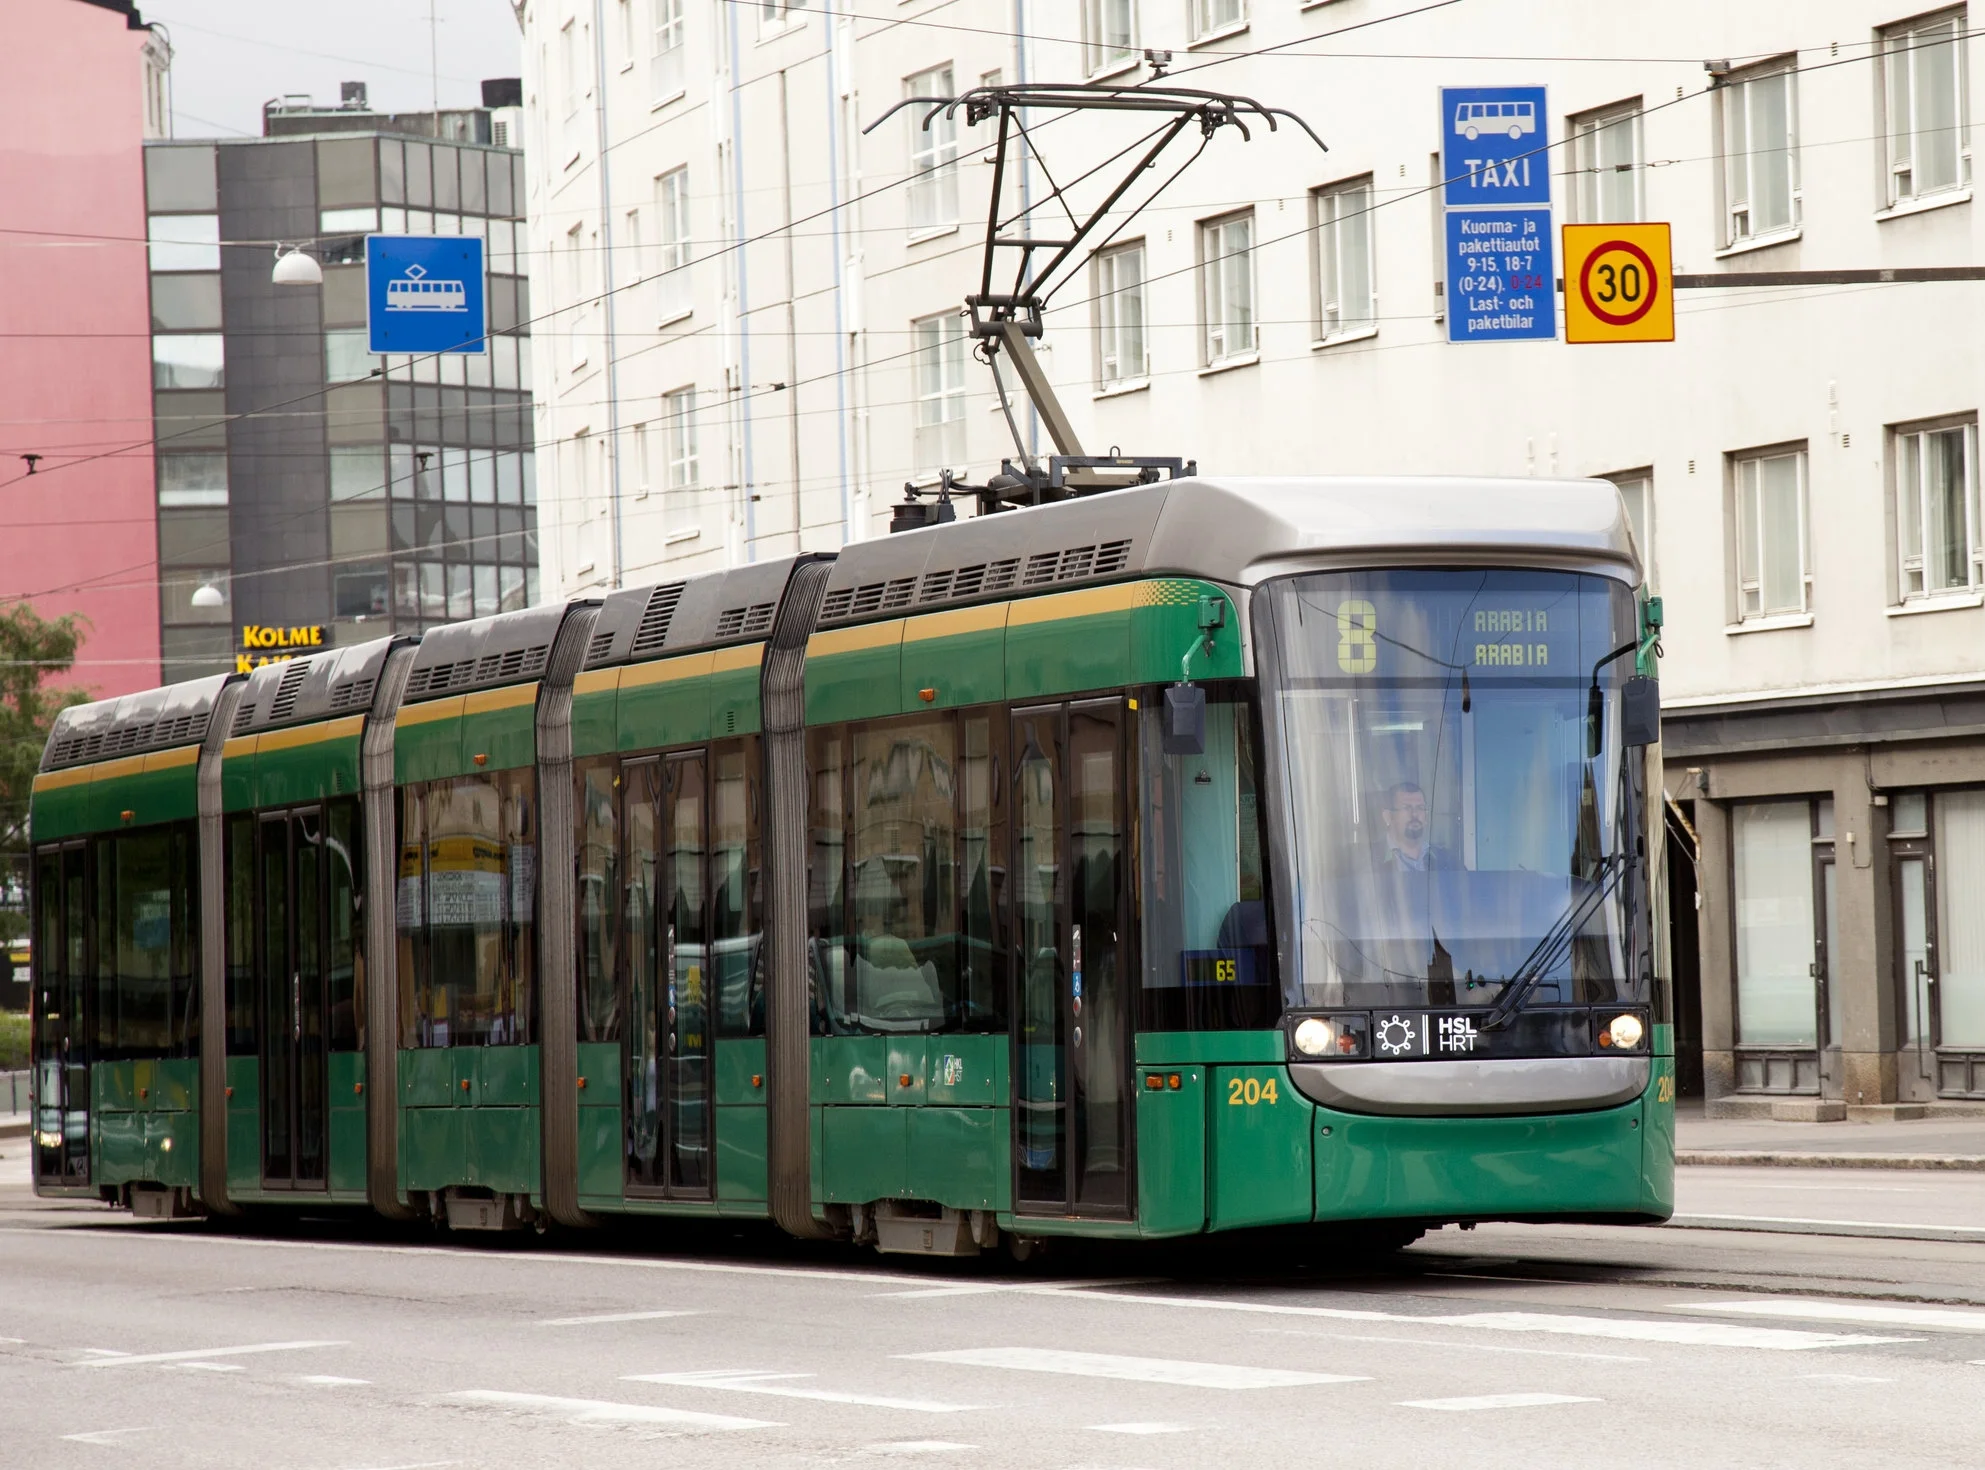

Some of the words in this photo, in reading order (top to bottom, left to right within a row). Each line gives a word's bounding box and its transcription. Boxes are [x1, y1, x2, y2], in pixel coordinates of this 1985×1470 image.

[1464, 158, 1530, 188] TAXI
[1461, 219, 1517, 234] Kuorma-
[1523, 218, 1536, 235] ja
[1459, 236, 1540, 256] pakettiautot
[1504, 255, 1533, 271] 18-7
[1511, 274, 1543, 290] 0-24
[1597, 264, 1640, 303] 30
[1469, 296, 1504, 312] Last-
[1509, 295, 1534, 310] och
[1468, 313, 1534, 333] paketbilar
[1475, 610, 1548, 632] ARABIA
[243, 625, 322, 648] KOLME
[1337, 599, 1377, 674] 8
[1475, 644, 1548, 666] ARABIA
[1216, 960, 1236, 982] 65
[1439, 1017, 1477, 1034] HSL
[1440, 1034, 1477, 1051] HRT
[1228, 1077, 1278, 1105] 204
